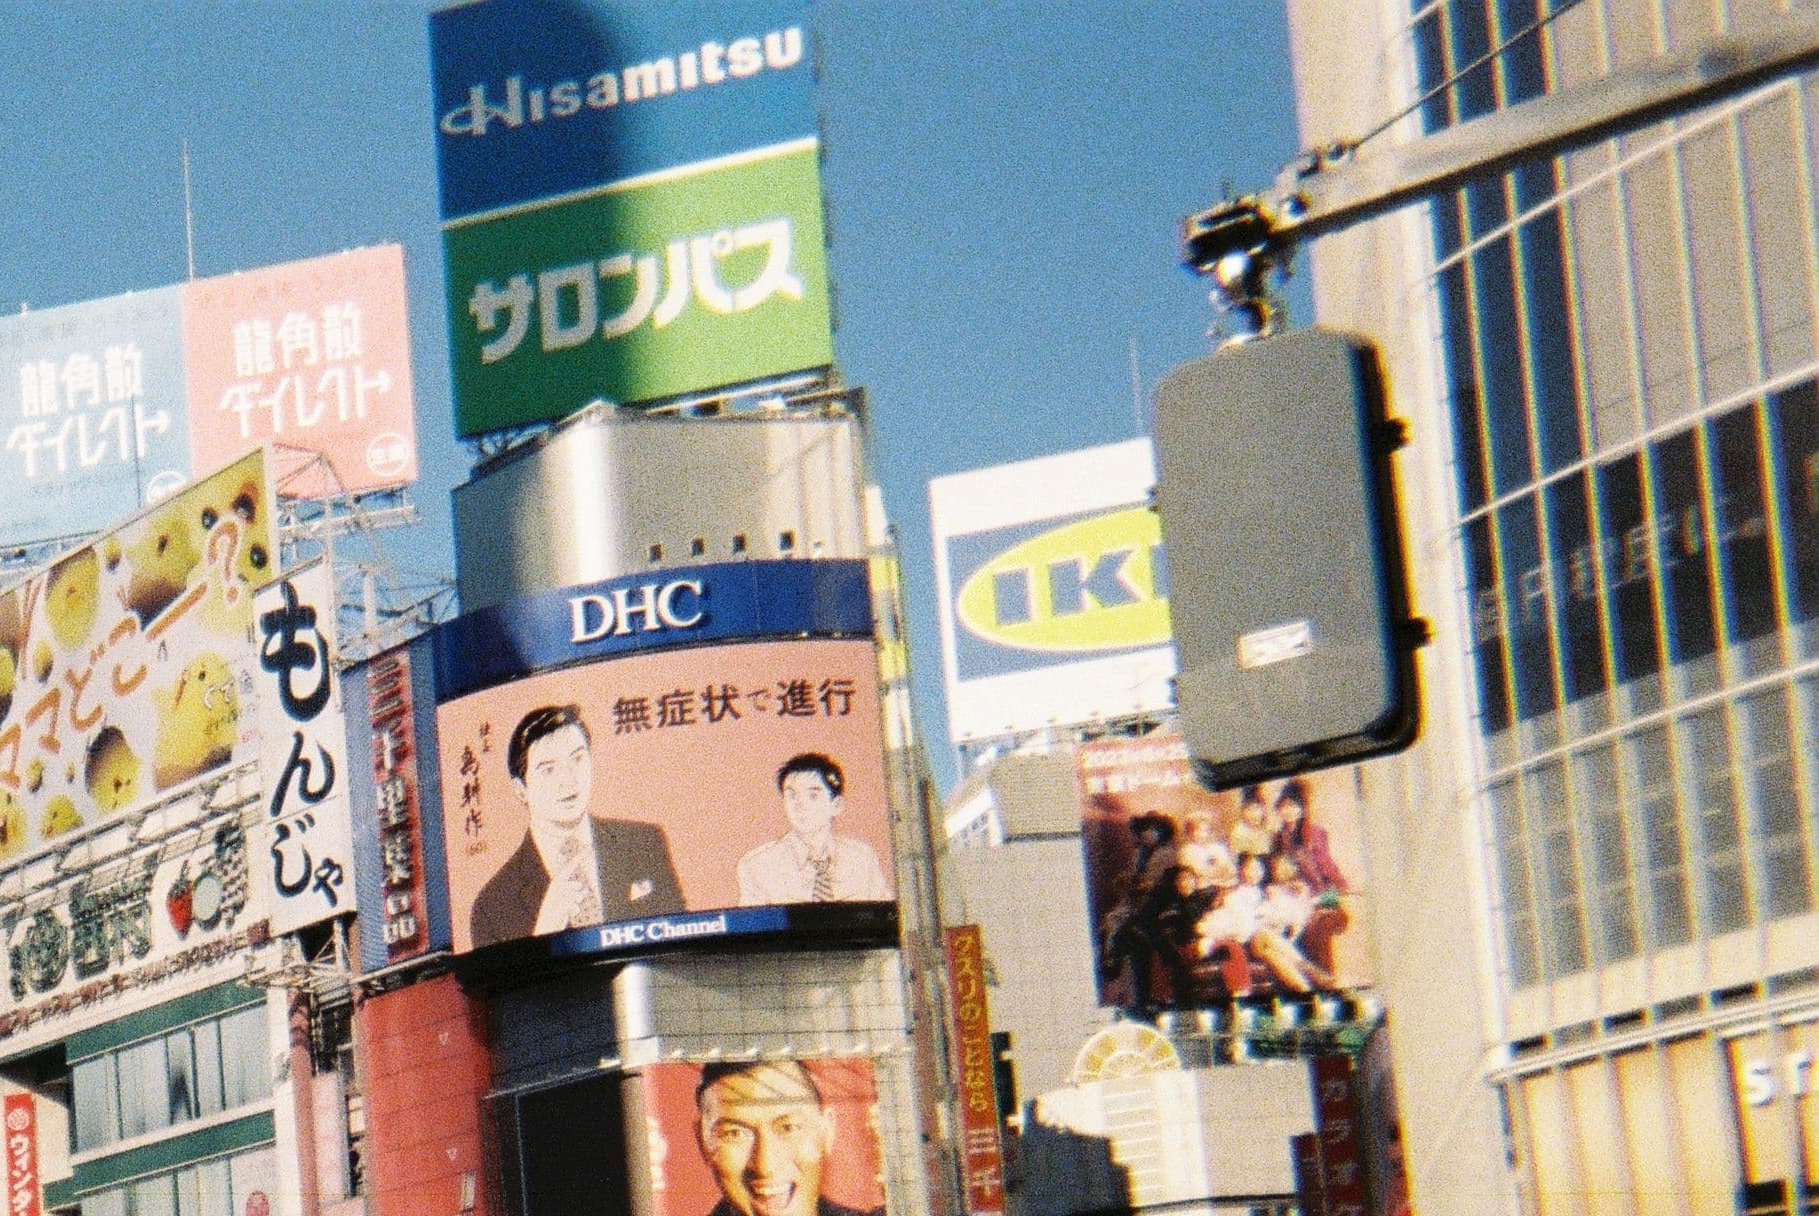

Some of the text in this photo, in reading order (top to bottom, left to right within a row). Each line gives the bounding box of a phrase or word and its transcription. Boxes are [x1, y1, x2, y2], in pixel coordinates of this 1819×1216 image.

[440, 27, 803, 136] Hisamitsu
[469, 219, 805, 364] サロンパス
[233, 300, 364, 376] 龍角散
[20, 343, 145, 417] 龍角散
[570, 580, 705, 644] DHC
[259, 579, 344, 906] もんじゃ
[613, 677, 857, 734] 無症状で進行
[600, 916, 727, 949] DHC Channel
